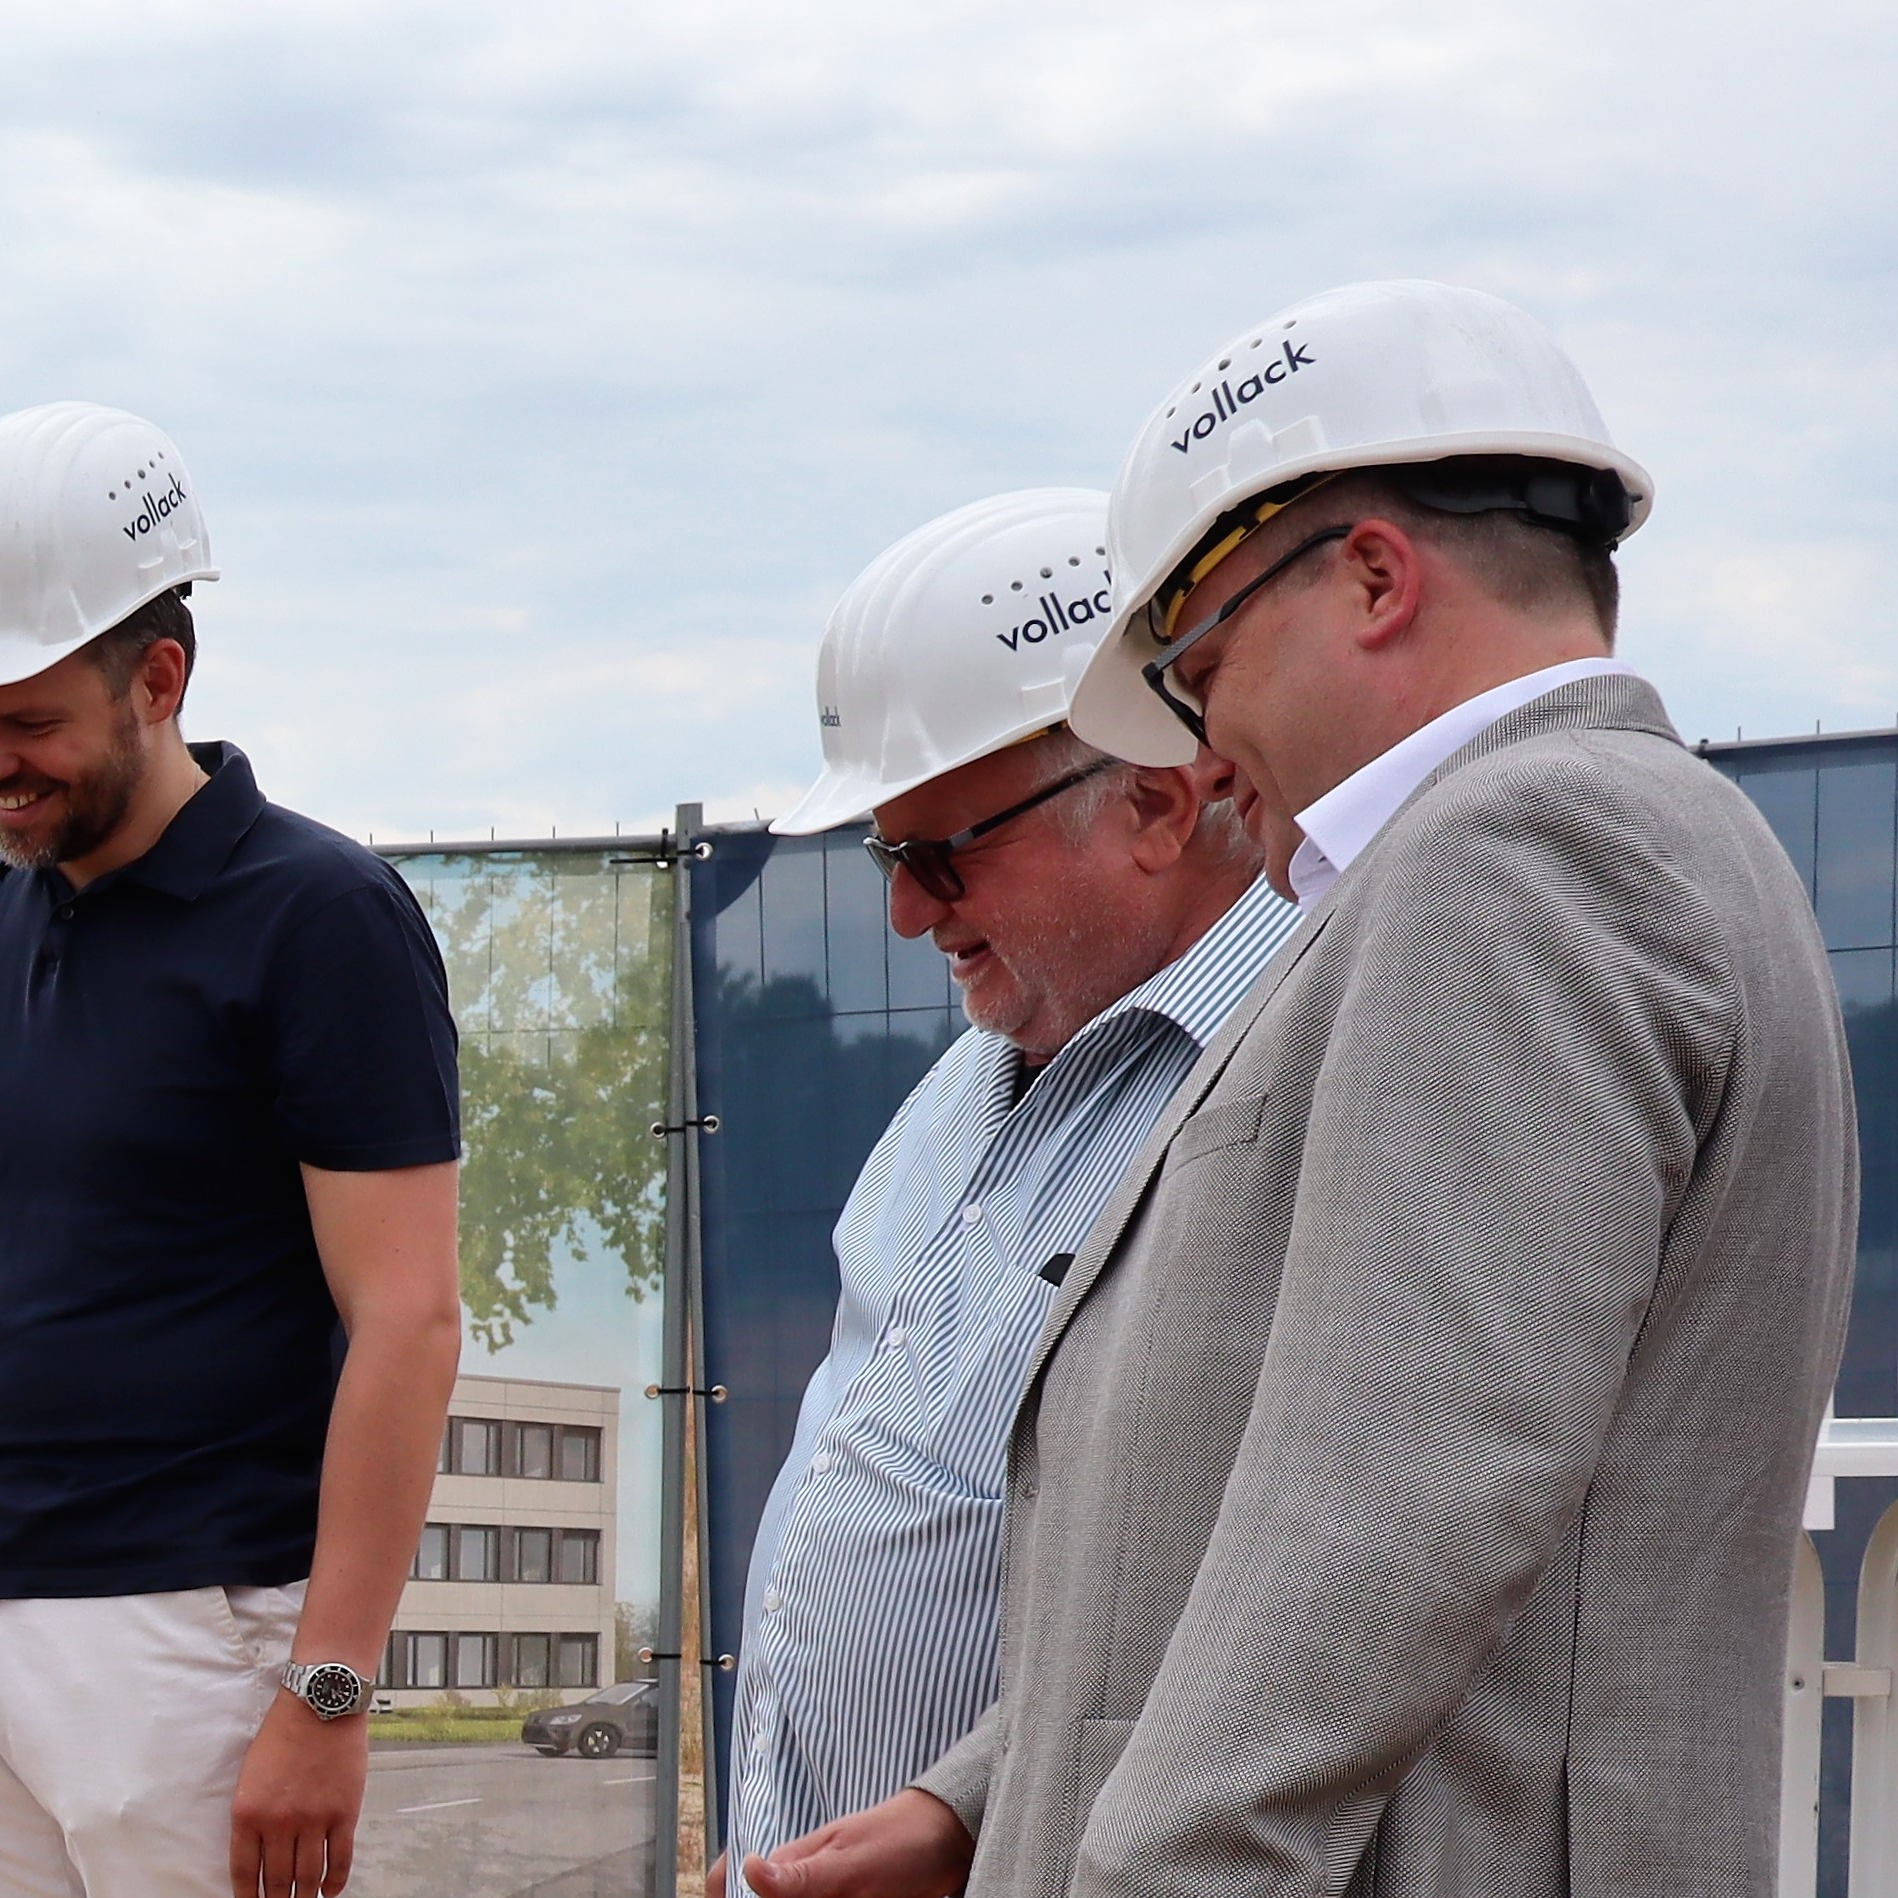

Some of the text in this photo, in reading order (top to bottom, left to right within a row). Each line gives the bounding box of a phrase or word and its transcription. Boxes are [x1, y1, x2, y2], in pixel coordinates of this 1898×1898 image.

[1170, 340, 1317, 455] vollack
[123, 472, 187, 542] vollack
[996, 569, 1112, 652] vollac
